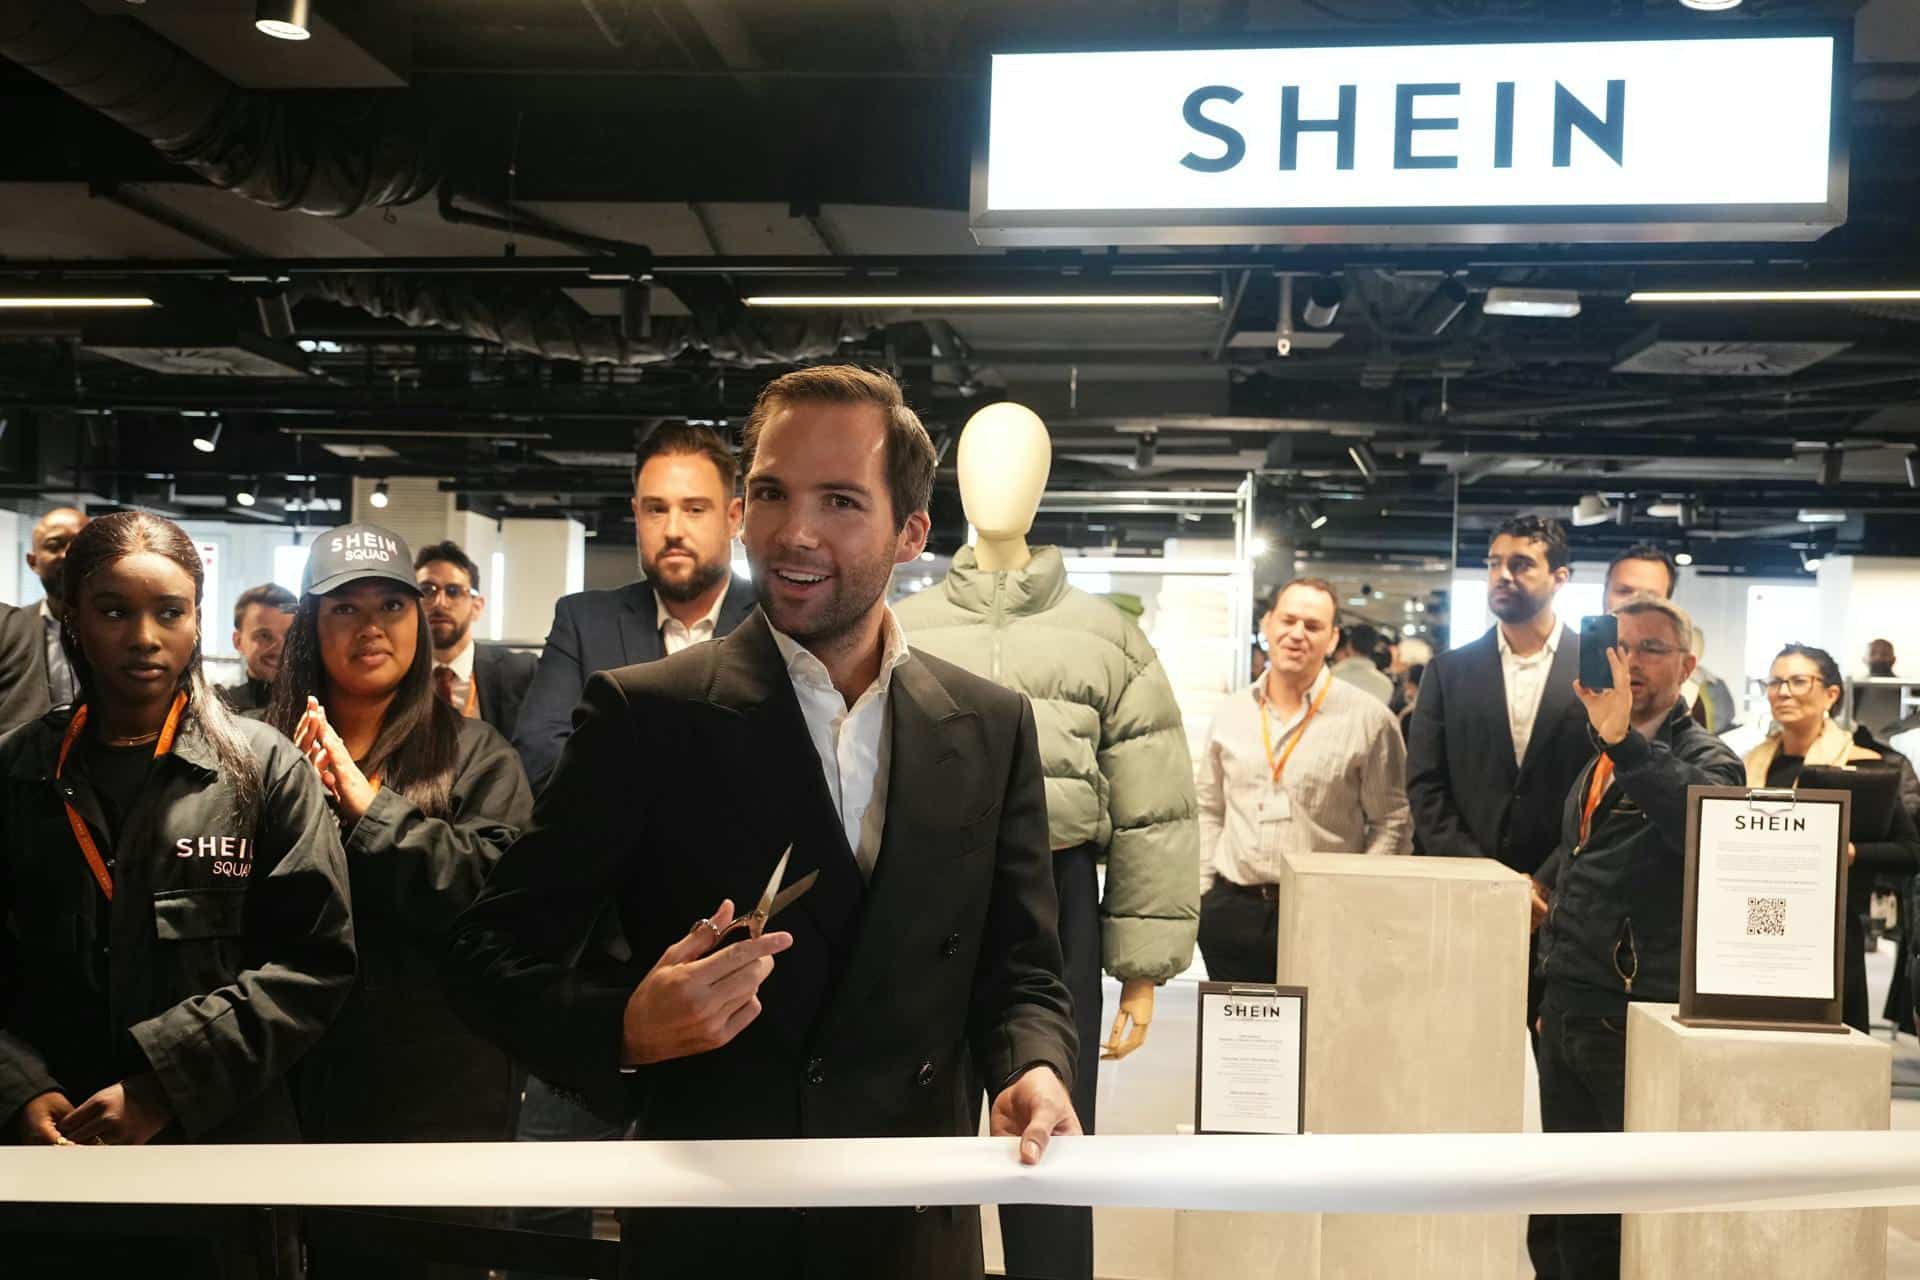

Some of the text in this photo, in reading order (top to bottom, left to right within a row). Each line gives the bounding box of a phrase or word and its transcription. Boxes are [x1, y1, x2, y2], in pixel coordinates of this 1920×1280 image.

[1179, 79, 1626, 173] SHEIN
[331, 532, 398, 556] SHEIN
[344, 549, 390, 562] SQUAD
[1735, 815, 1806, 832] SHEIN
[176, 836, 254, 859] SHEI
[212, 860, 252, 877] SQUA
[1223, 1004, 1280, 1018] SHEIN
